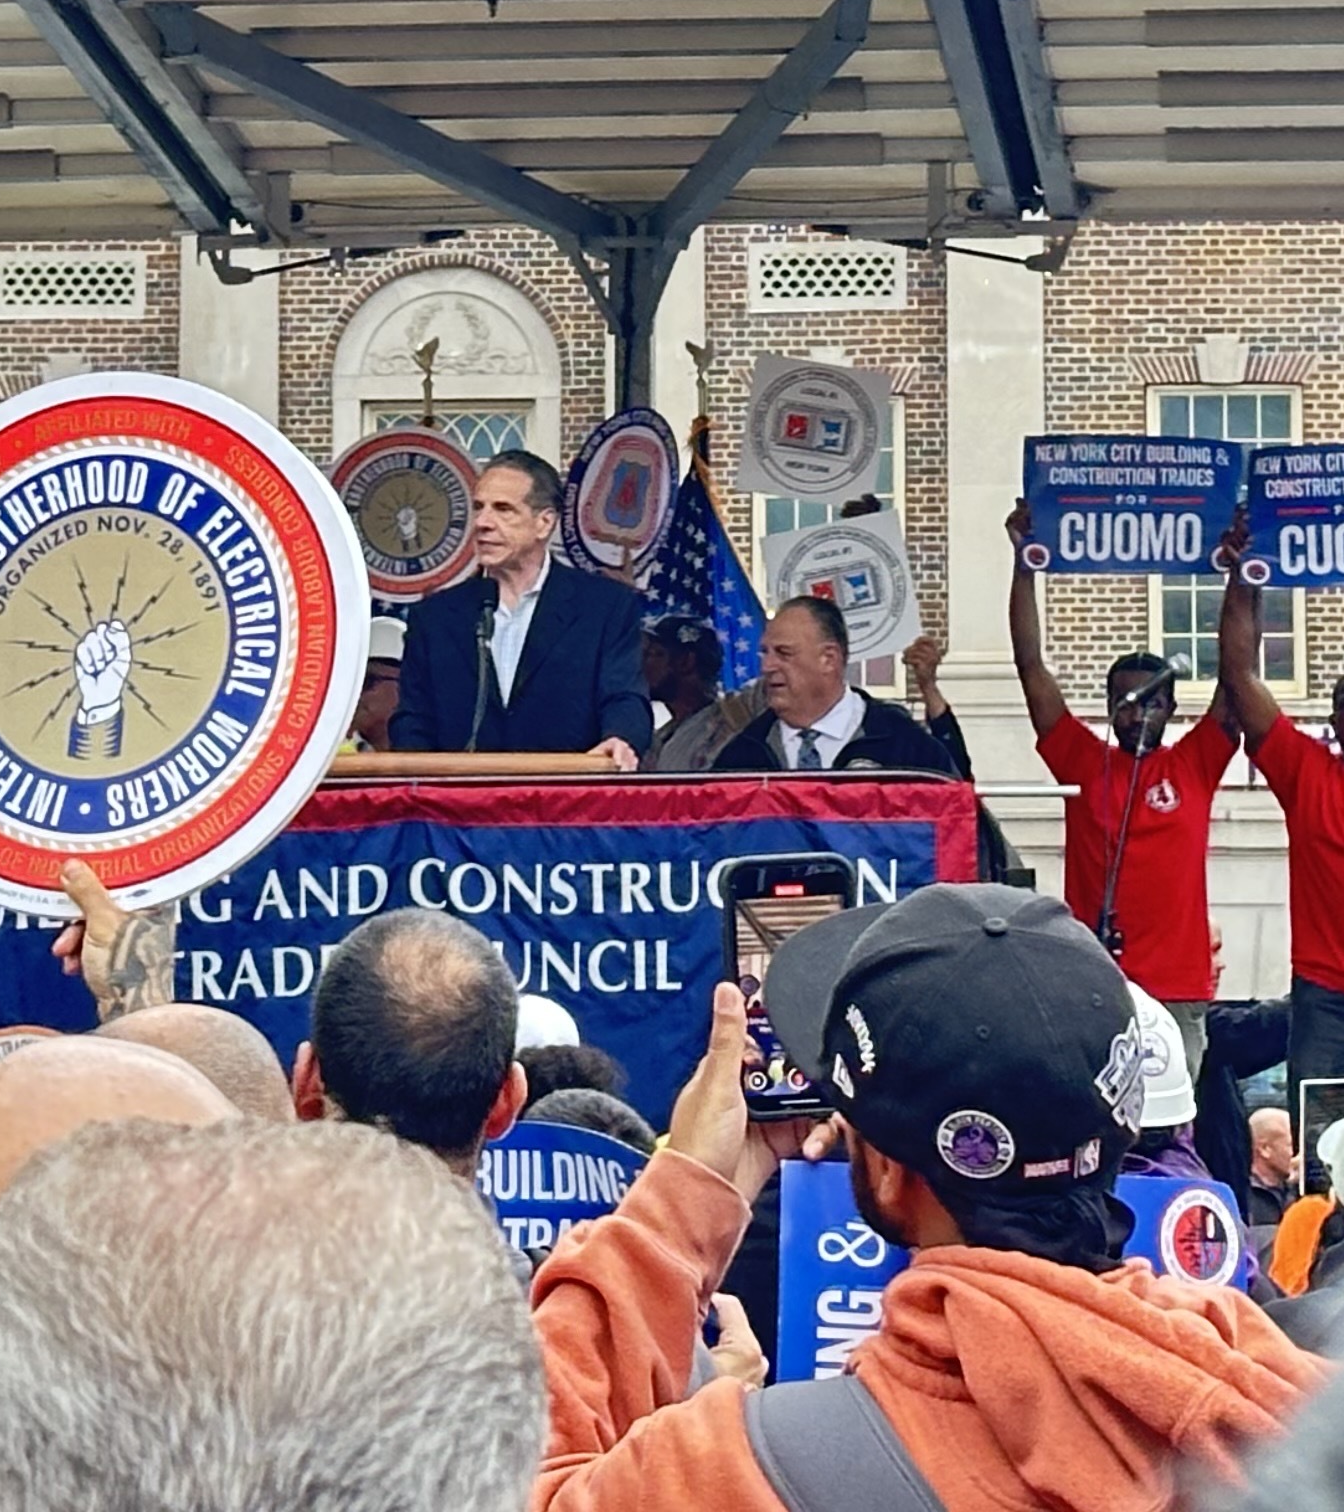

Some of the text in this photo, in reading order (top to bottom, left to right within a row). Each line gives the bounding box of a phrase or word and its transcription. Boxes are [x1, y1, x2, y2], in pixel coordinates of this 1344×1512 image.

[34, 409, 192, 442] AFFILIATED WITH
[1035, 444, 1230, 466] NEW YORK CITY BUILDING &
[1049, 467, 1215, 486] CONSTRUCTION TRADES
[1255, 456, 1282, 475] NEW
[1284, 454, 1323, 474] YORK
[157, 472, 206, 521] OF
[224, 445, 304, 534] CONGRESS
[1114, 494, 1147, 505] FOR
[1059, 511, 1203, 562] CUOMO
[97, 515, 150, 539] NOV.
[157, 530, 185, 562] 28,
[189, 560, 221, 612] 1891
[292, 535, 326, 618] LABOUR
[197, 504, 277, 698] ELECTRICAL
[287, 624, 326, 730] CANADIAN
[277, 732, 298, 750] &
[106, 710, 250, 828] WORKERS
[149, 750, 285, 867] ORGANIZATIONS
[27, 851, 145, 881] INDTRIAL
[253, 863, 388, 921] AND
[817, 1221, 887, 1268] &
